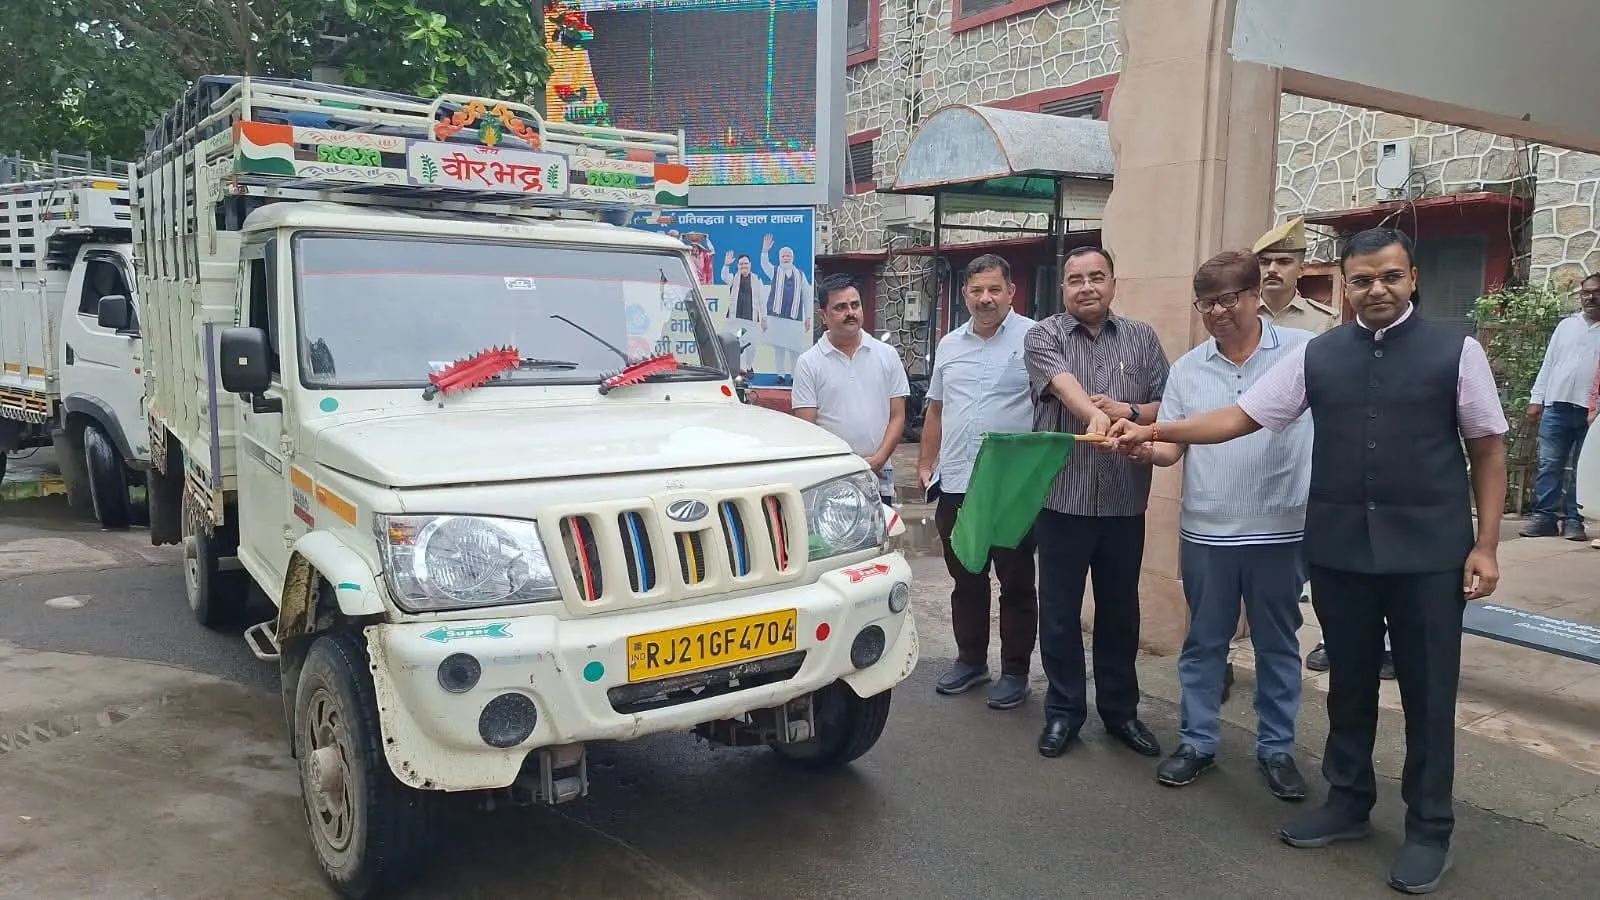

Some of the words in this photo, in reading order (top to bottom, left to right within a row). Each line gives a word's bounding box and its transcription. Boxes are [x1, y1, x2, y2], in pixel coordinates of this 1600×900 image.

[678, 212, 724, 225] प्रतिबद्धता
[735, 214, 767, 226] कुशल
[770, 214, 804, 224] शासन
[447, 629, 489, 637] Super
[646, 618, 794, 669] RJ21GF4704
